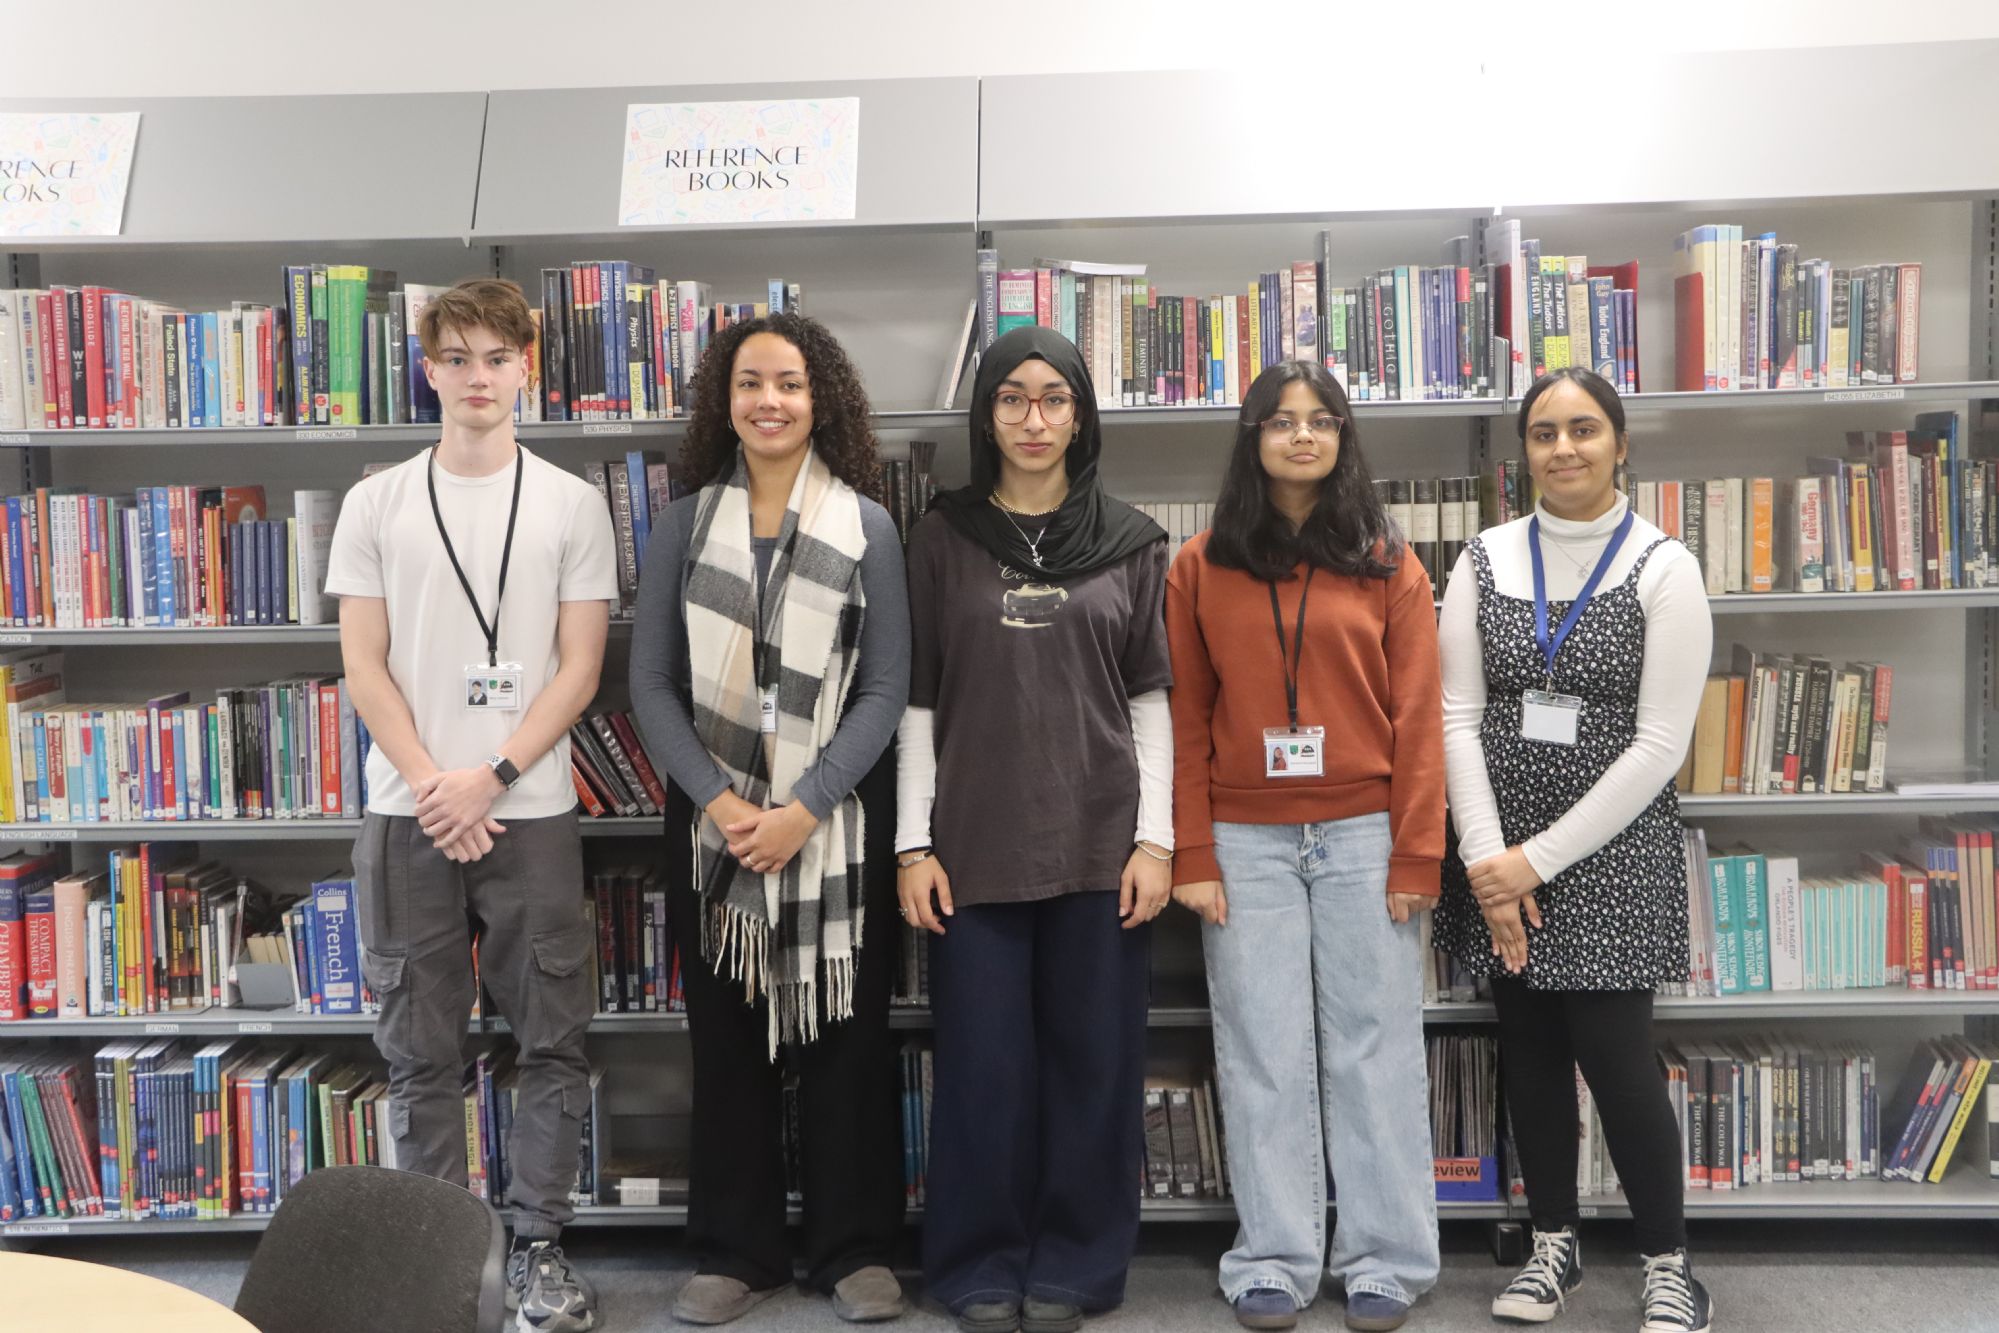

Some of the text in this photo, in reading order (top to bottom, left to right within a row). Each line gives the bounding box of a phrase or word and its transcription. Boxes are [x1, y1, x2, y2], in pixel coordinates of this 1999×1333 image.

[665, 146, 808, 168] REFERENCE
[689, 169, 790, 192] BOOKS
[120, 305, 130, 332] BEYOND
[294, 275, 306, 338] ECONOMICS
[1544, 300, 1553, 330] Tudors
[1556, 282, 1564, 329] The Tudors
[122, 334, 130, 348] THE
[630, 317, 639, 348] Physics
[1384, 306, 1396, 374] GOTHIC
[1599, 304, 1611, 358] Tudor England
[122, 348, 131, 362] RED
[618, 472, 632, 529] CHEMISTRY
[632, 485, 641, 520] CHEMISTRY
[1807, 492, 1819, 540] Germany
[1787, 672, 1804, 755] PRUSSIA myth and reality
[30, 919, 40, 975] THESAURUS
[39, 918, 51, 974] COMPACT
[64, 906, 74, 992] ENGLISH PHRASES
[317, 888, 348, 981] Collins French
[1912, 910, 1923, 958] RUSSIA
[104, 955, 113, 986] NATIVES
[1434, 1163, 1480, 1176] eview
